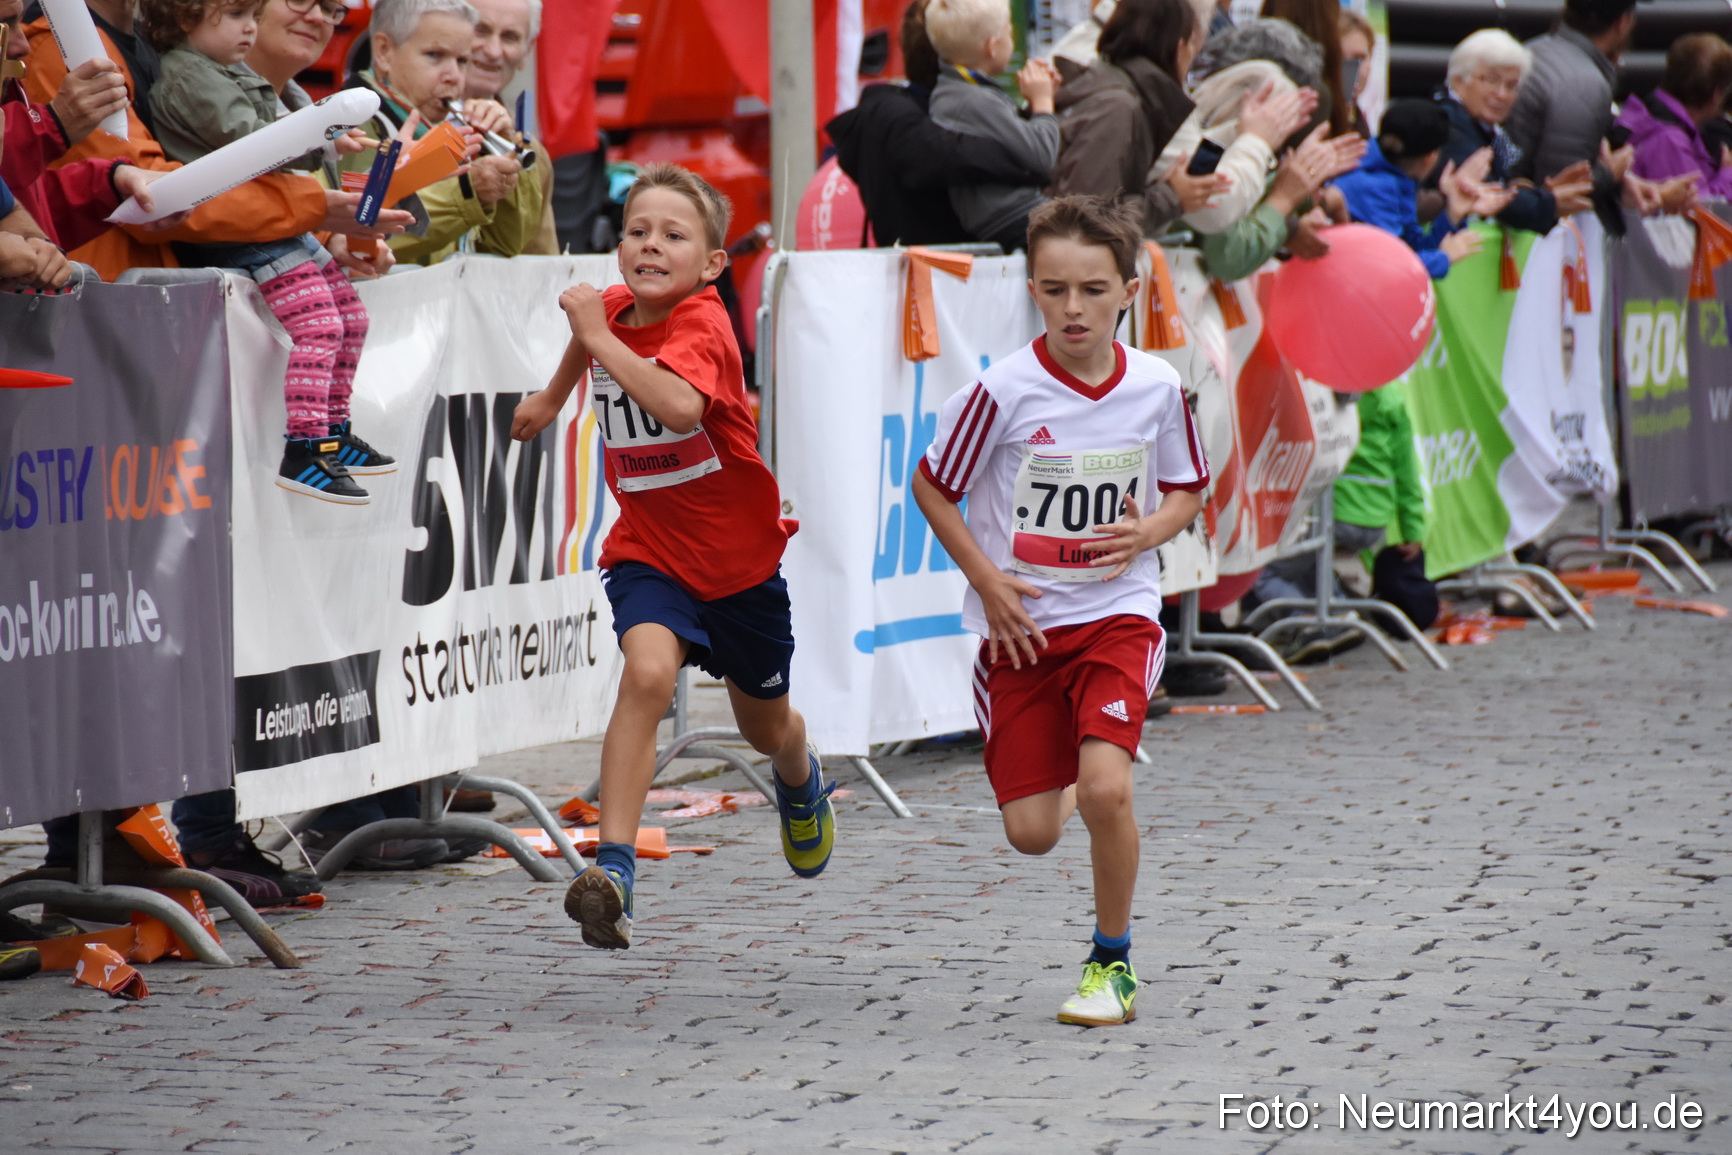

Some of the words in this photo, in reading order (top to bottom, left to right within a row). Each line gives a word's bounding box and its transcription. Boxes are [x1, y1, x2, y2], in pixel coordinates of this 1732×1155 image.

[619, 453, 680, 473] Thomas
[1027, 463, 1075, 474] NeuerMarkt
[1083, 451, 1144, 470] BOCK
[1245, 427, 1314, 493] Braun
[402, 613, 503, 707] stadtwrke
[315, 693, 337, 727] die
[1101, 706, 1129, 722] adidas
